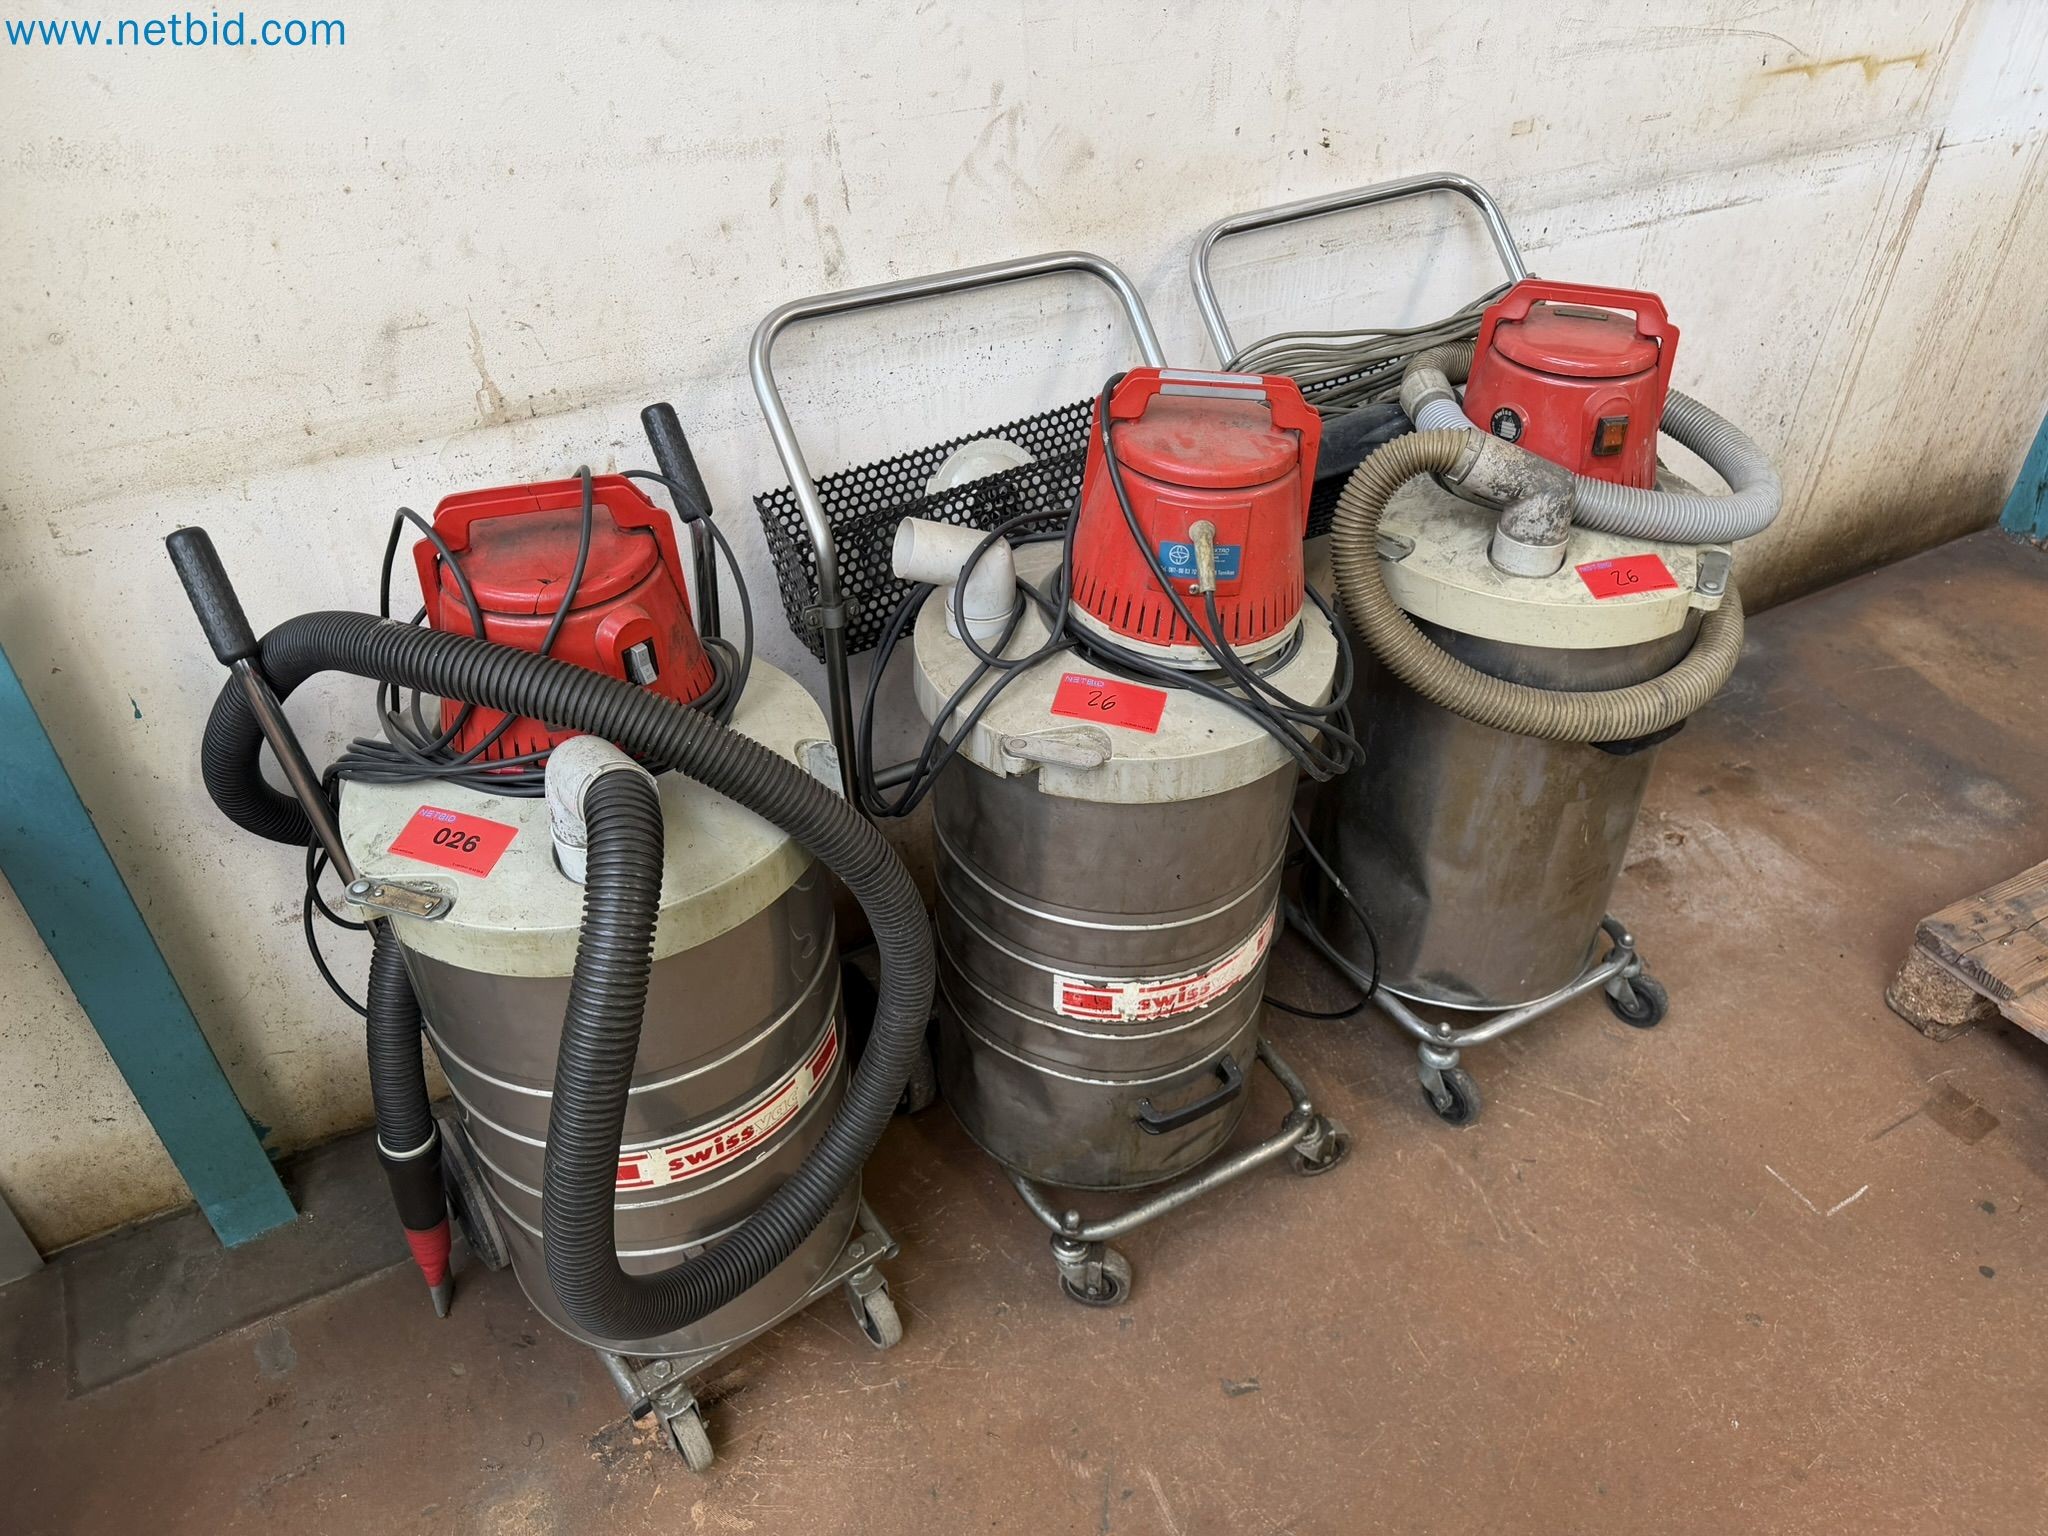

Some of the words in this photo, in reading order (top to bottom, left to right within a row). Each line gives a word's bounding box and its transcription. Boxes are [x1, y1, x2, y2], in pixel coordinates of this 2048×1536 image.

[1610, 569, 1639, 586] 26
[1064, 675, 1105, 688] NETBID
[1087, 690, 1117, 711] 26
[418, 808, 457, 823] NETBID
[432, 827, 481, 853] 026
